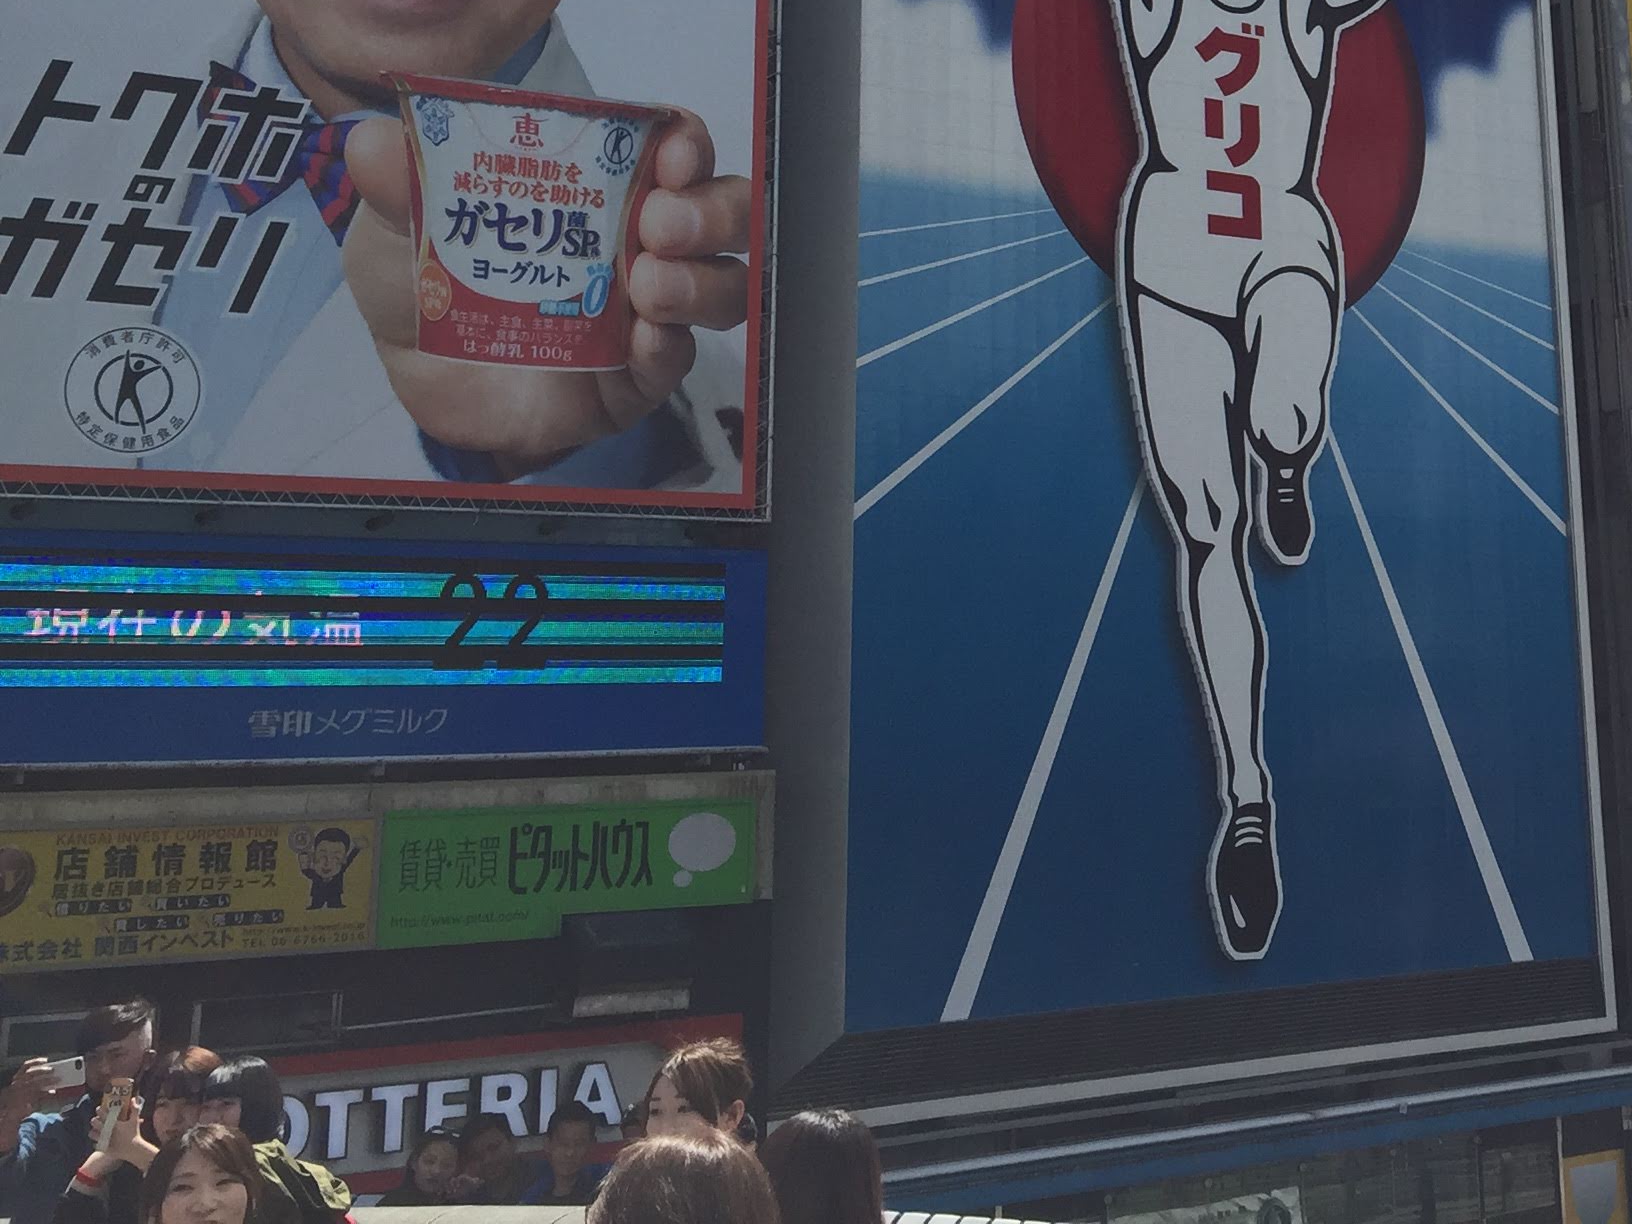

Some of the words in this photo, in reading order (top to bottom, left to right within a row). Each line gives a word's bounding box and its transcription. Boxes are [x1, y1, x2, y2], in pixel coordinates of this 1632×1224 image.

[3, 59, 306, 180] トクホ
[509, 112, 550, 148] 恵
[1194, 21, 1264, 241] グリコ
[473, 150, 582, 183] 内臓脂肪を
[122, 174, 176, 205] の
[453, 170, 606, 209] 減らすのを助ける
[0, 197, 291, 315] ガセリ
[472, 257, 571, 288] ヨーグルト
[84, 330, 186, 364] 消費者庁許可
[530, 345, 573, 362] 100g
[76, 410, 185, 450] 特定保健用食品
[248, 707, 449, 739] 雪印メグミルク
[117, 830, 169, 843] INVEST
[175, 826, 279, 842] CORPORATION
[54, 839, 279, 881] 店舗情報館
[399, 836, 501, 893] 賃貸・売買
[507, 818, 654, 896] ピタットハウス
[95, 929, 234, 957] 関西インベスト
[281, 1062, 622, 1161] OTTERIA
